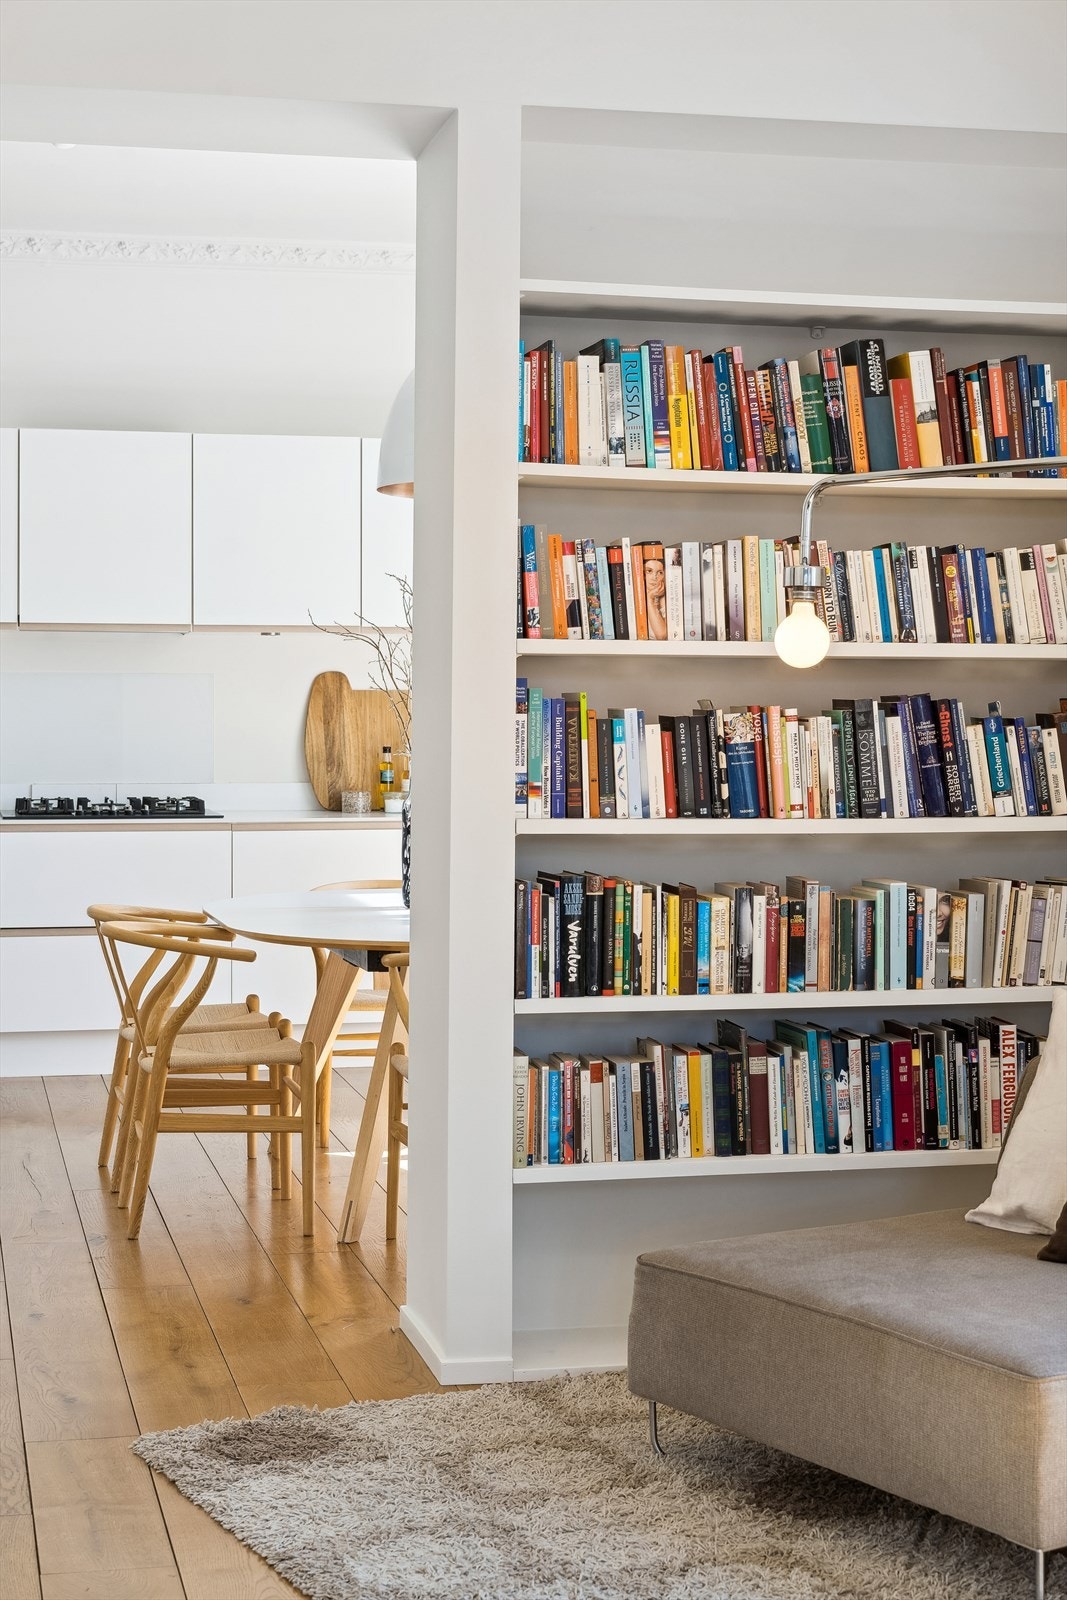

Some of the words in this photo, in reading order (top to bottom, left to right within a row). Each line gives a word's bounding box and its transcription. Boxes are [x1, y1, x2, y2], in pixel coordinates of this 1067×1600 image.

[624, 360, 641, 422] RUSSIA
[747, 376, 756, 399] OPEN
[673, 398, 683, 427] Negotiation
[750, 402, 760, 421] CITY
[763, 431, 773, 457] GLENNY
[857, 431, 866, 461] CHAOS
[526, 551, 535, 571] War
[825, 601, 834, 613] TO
[827, 615, 838, 633] RUN
[553, 717, 563, 749] Building
[752, 712, 763, 742] yoga
[771, 713, 783, 766] massasje
[940, 711, 954, 748] Ghost
[1018, 725, 1027, 755] TALIBAN
[553, 750, 563, 791] Capitalism
[858, 732, 872, 787] SOMME
[991, 736, 1005, 788] Griechenland
[946, 765, 956, 804] HARRIS
[951, 764, 963, 802] ROBERT
[1040, 777, 1048, 801] OBAMA
[567, 920, 582, 983] Varulven
[820, 1039, 829, 1069] MEYER
[1002, 1030, 1015, 1059] ALEX
[515, 1084, 524, 1112] JOHN
[1003, 1063, 1016, 1124] FERGUSON
[516, 1116, 524, 1153] IRVING
